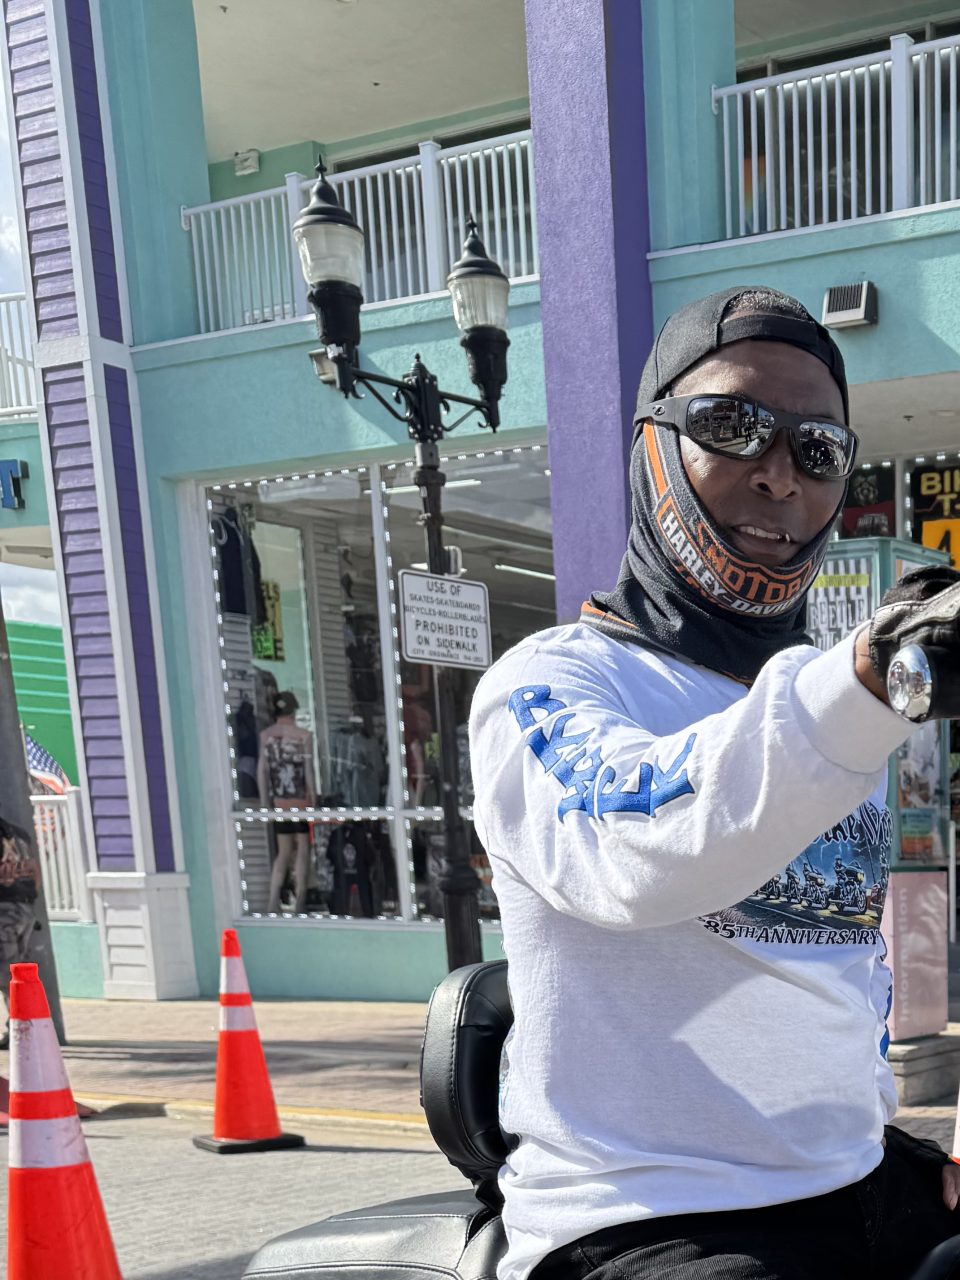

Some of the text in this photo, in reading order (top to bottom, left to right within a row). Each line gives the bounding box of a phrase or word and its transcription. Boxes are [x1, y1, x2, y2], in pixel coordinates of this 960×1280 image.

[427, 581, 462, 596] USE OF
[415, 620, 479, 639] PROHIBITED
[416, 635, 478, 653] ON SIDEWALK
[756, 927, 879, 945] ANNIVERSARY
